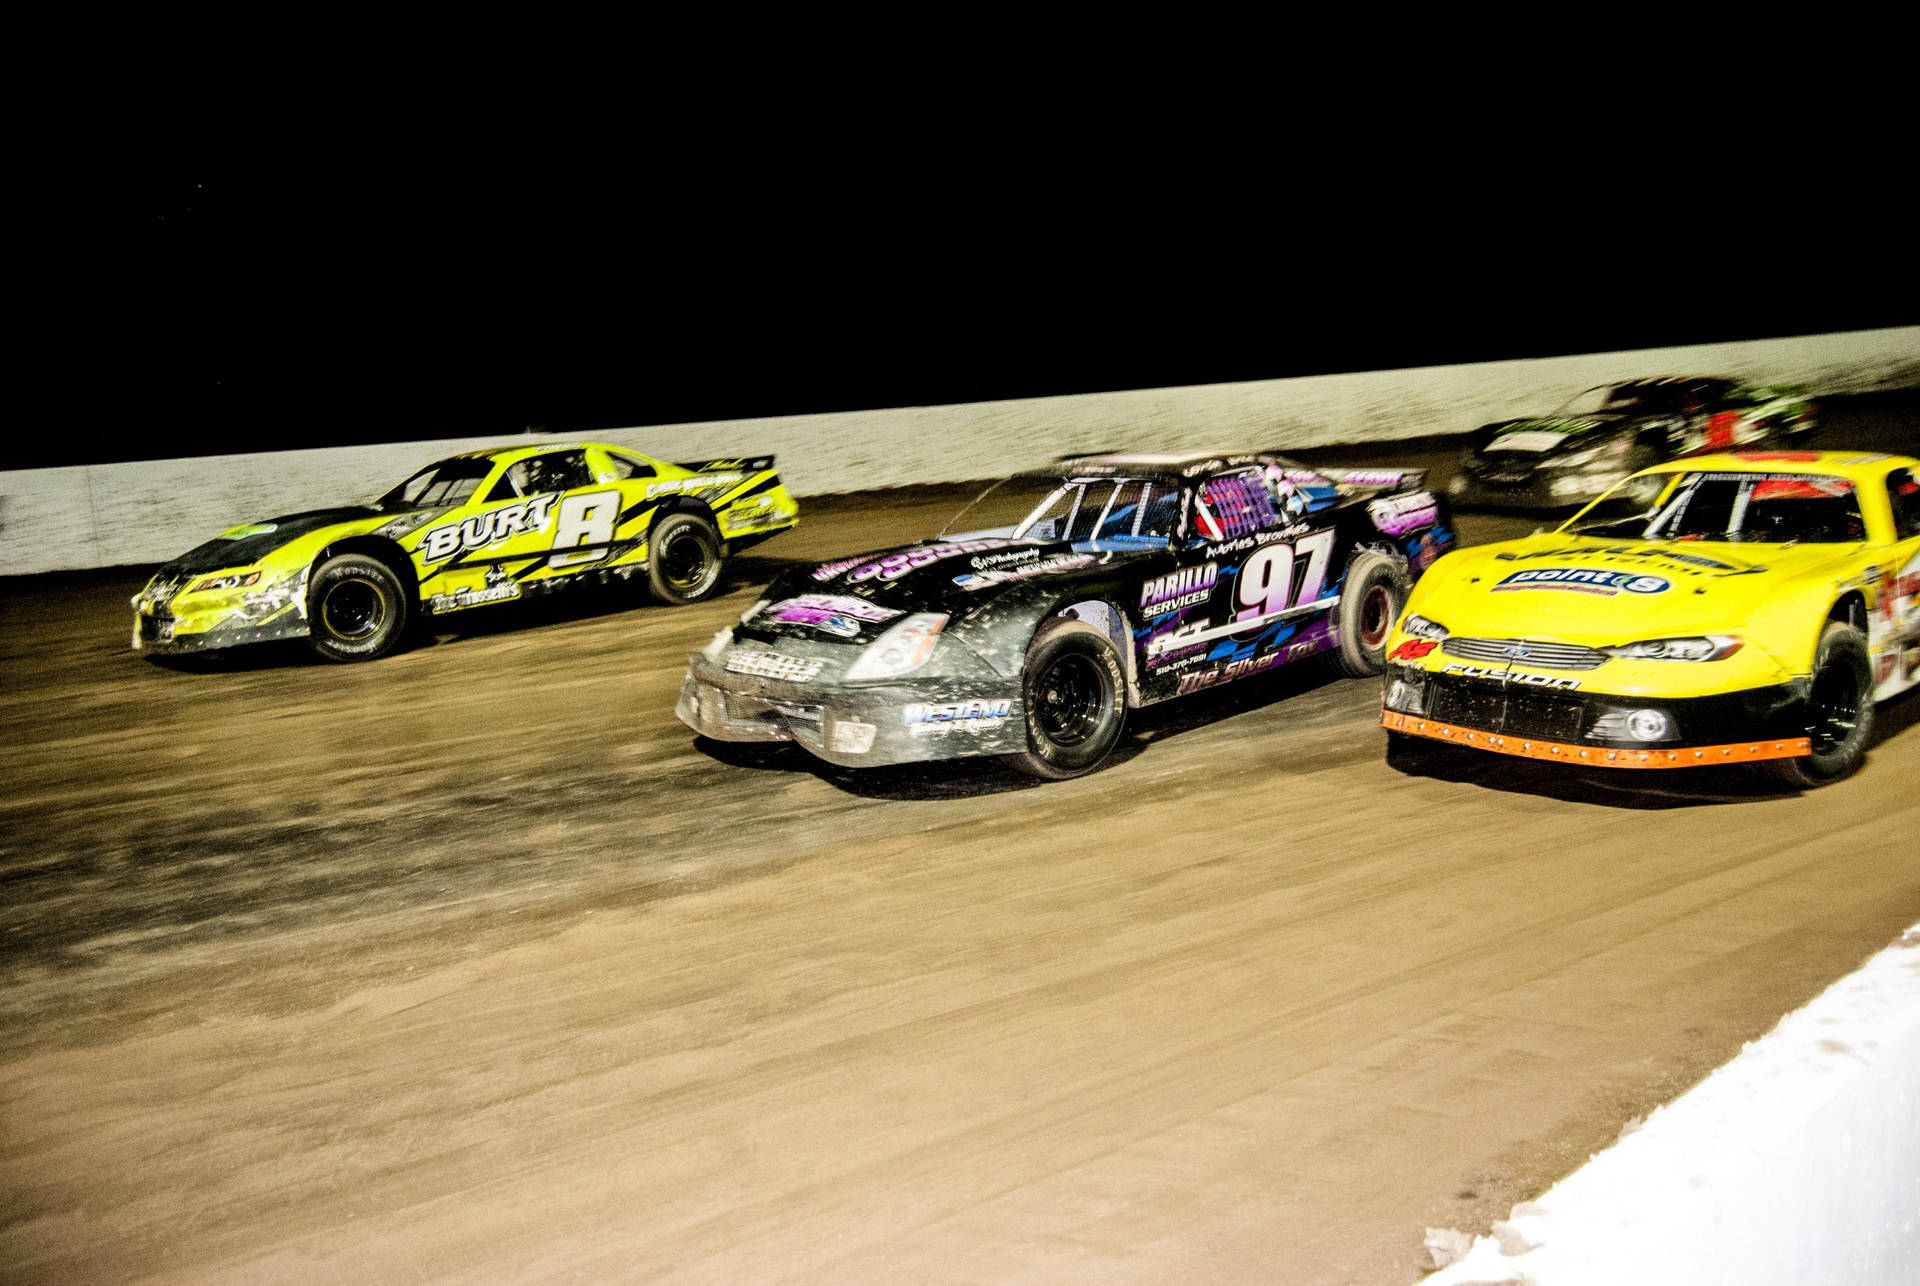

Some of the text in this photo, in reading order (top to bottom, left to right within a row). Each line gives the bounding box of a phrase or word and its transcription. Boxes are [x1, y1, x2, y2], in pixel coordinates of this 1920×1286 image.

[417, 491, 565, 565] BURT
[1140, 562, 1218, 609] PARILLO
[1233, 530, 1336, 638] 97
[1510, 568, 1612, 585] point
[1143, 588, 1210, 618] SERVICES
[1177, 669, 1219, 696] The
[1223, 651, 1279, 682] Silver
